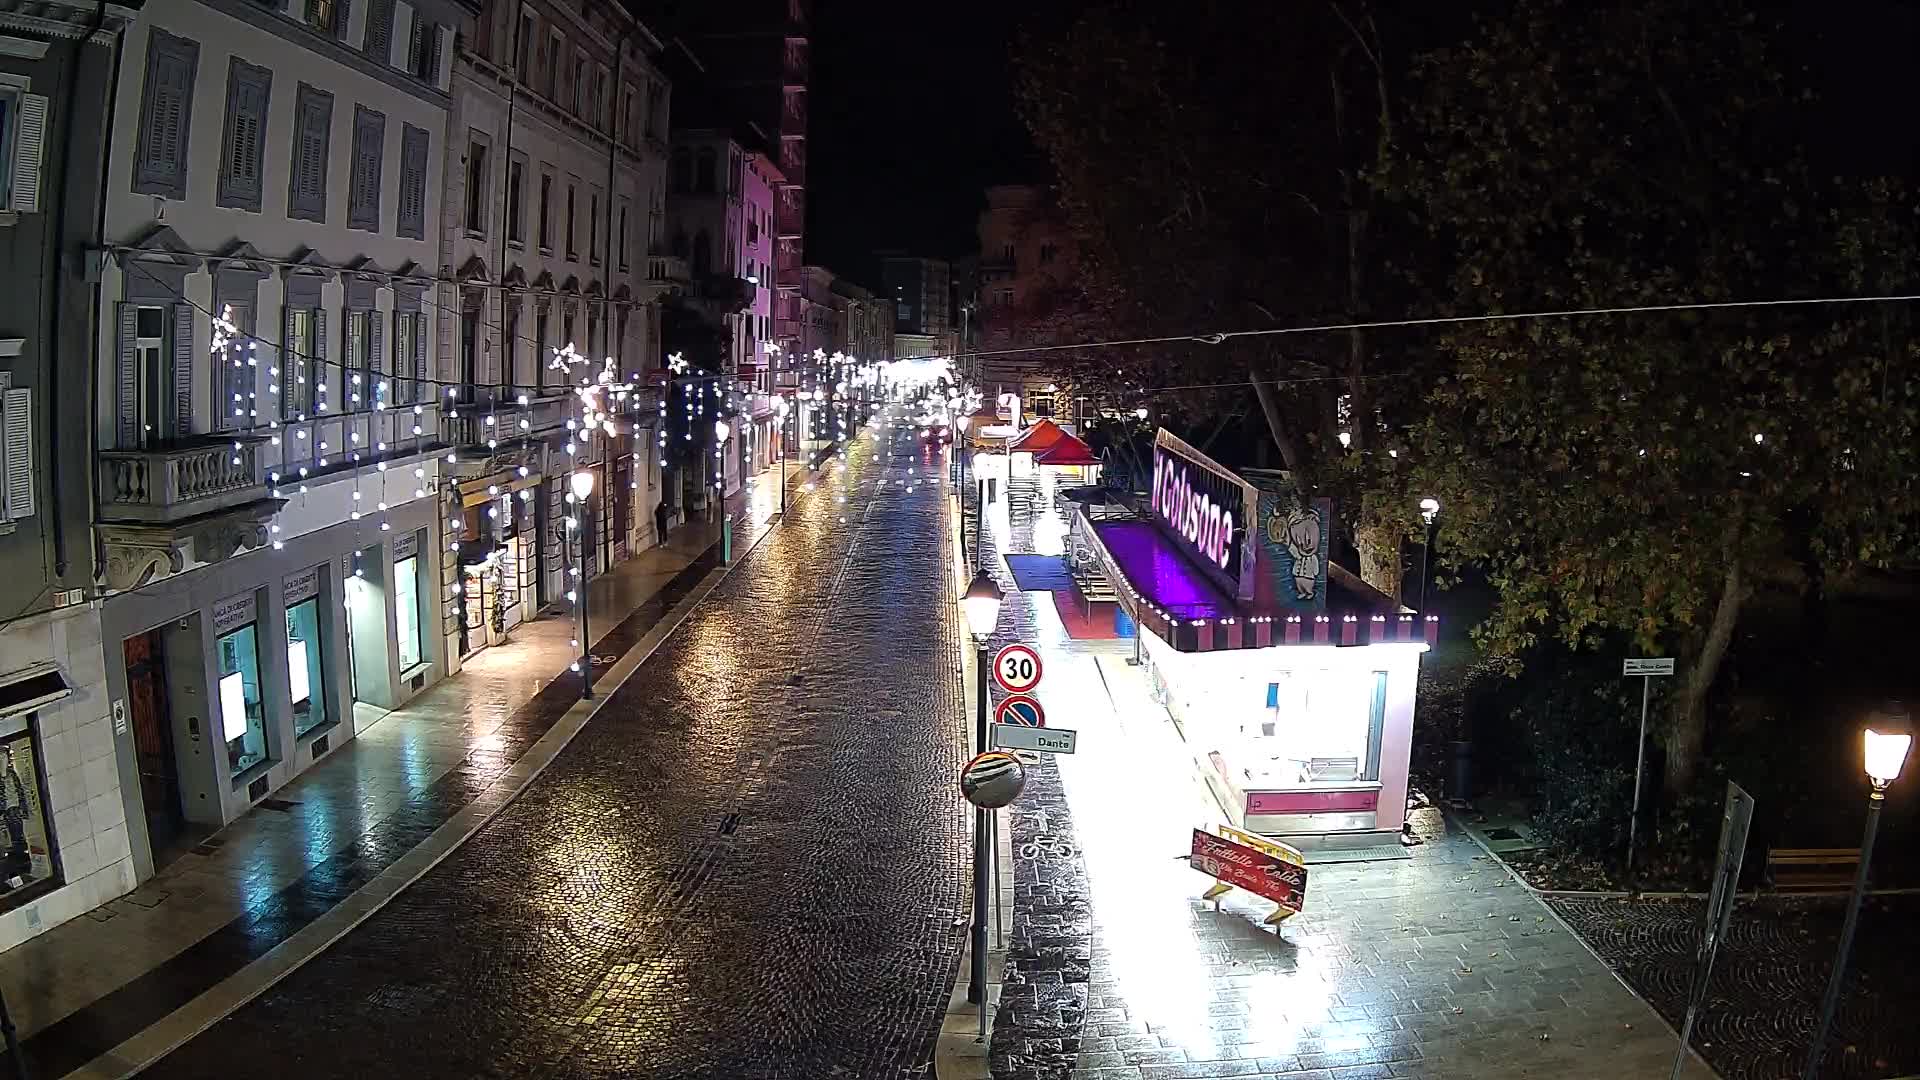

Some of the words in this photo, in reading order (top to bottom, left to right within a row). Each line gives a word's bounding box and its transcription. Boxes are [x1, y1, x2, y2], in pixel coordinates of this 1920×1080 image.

[1162, 457, 1234, 570] Golosone
[1005, 657, 1033, 680] 30
[1038, 737, 1069, 749] Dante
